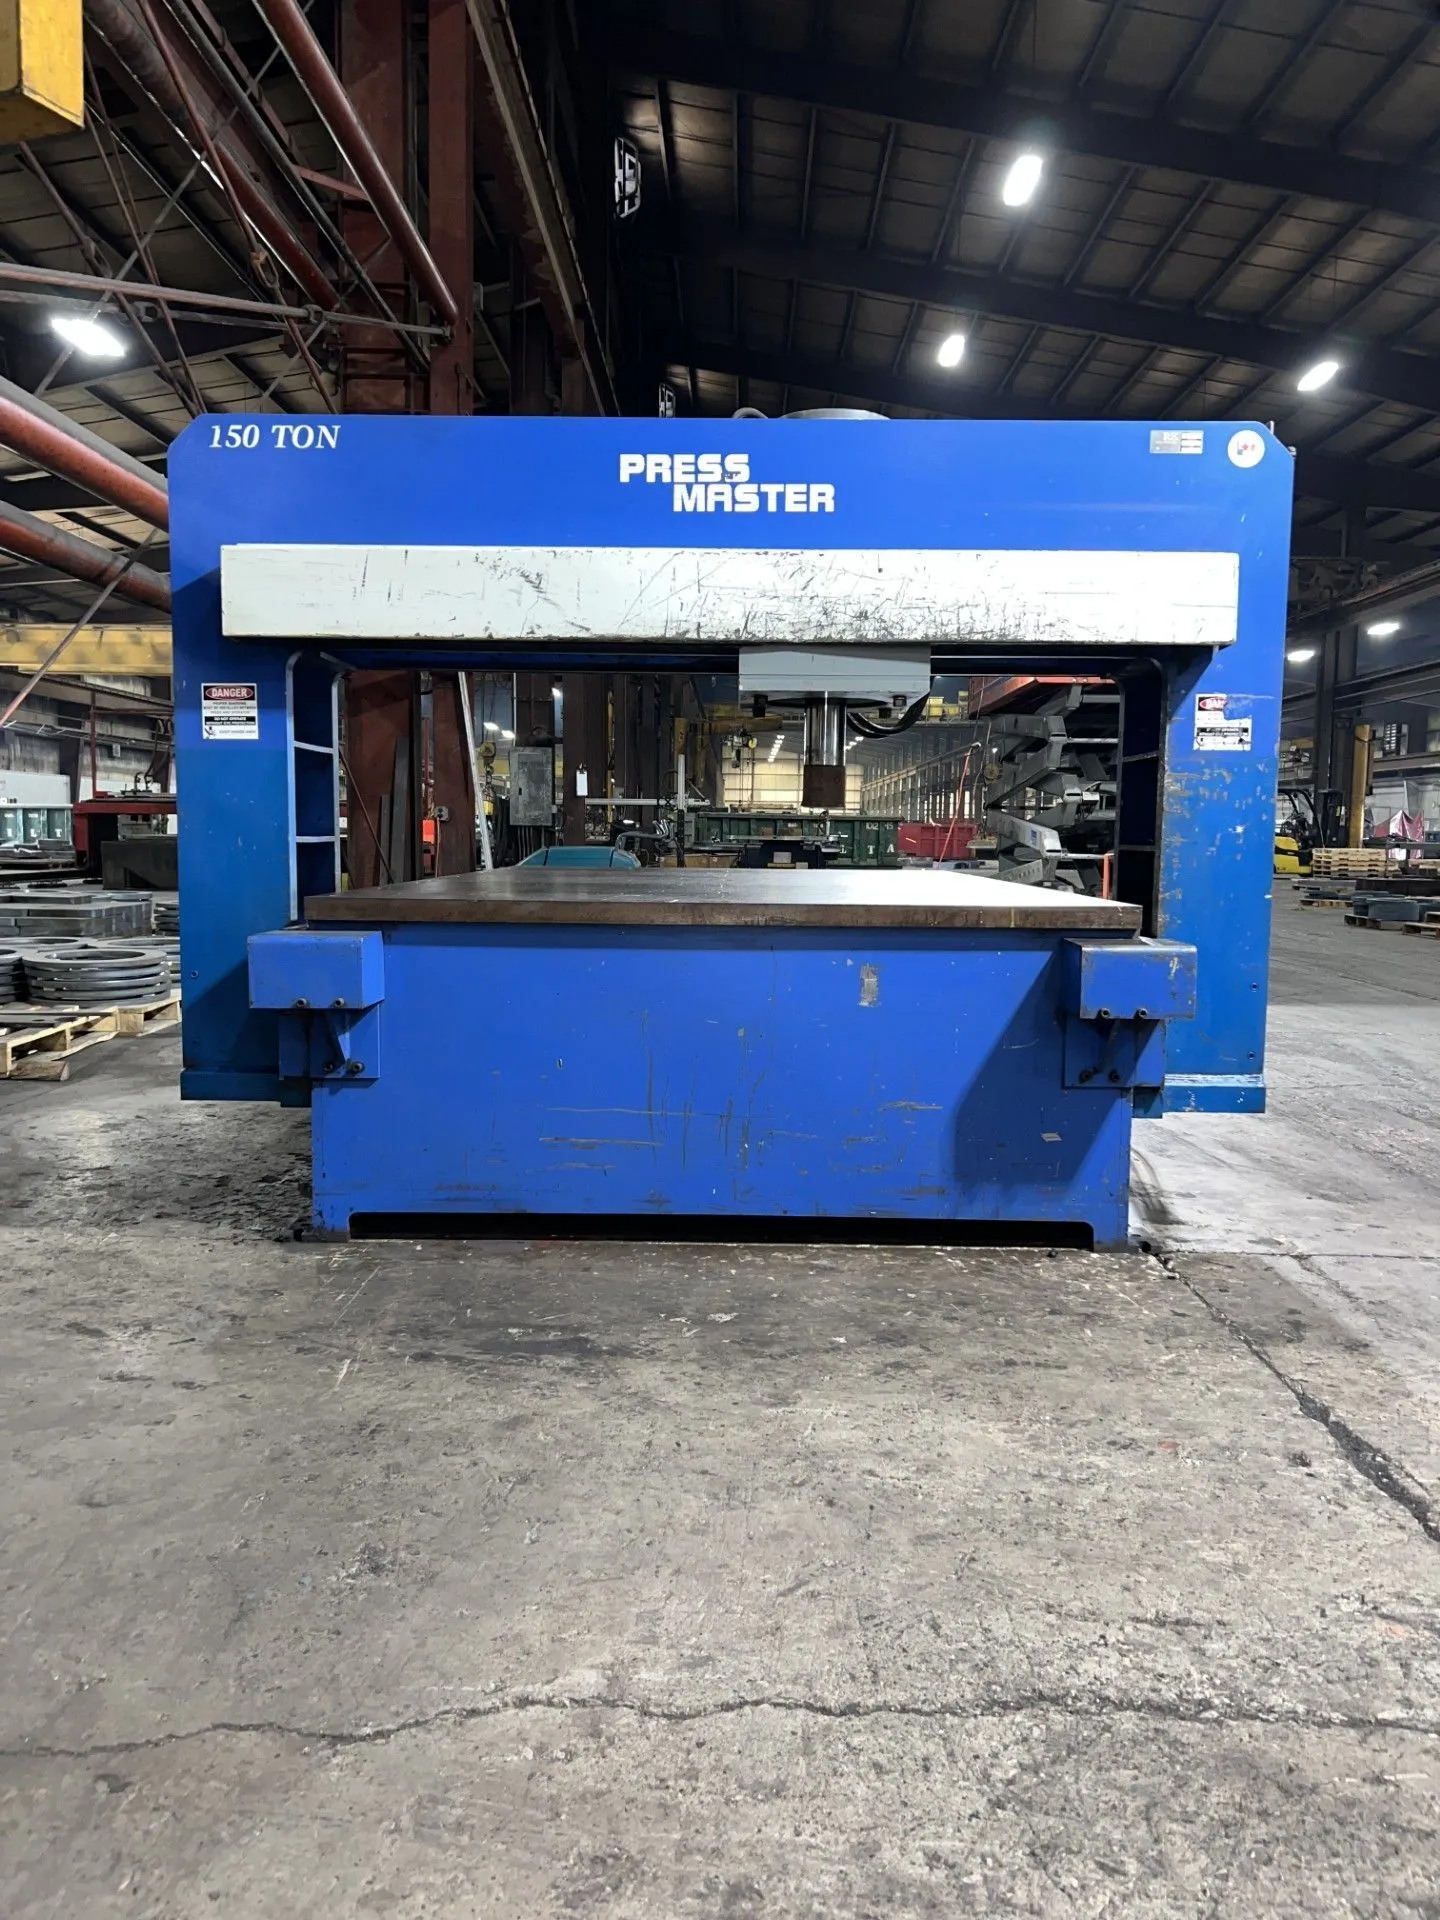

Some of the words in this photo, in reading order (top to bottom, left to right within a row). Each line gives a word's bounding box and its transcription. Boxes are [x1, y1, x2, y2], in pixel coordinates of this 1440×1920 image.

[209, 424, 260, 449] 150
[271, 424, 341, 449] TON
[619, 453, 750, 483] PRESS
[673, 483, 835, 512] MASTER
[211, 688, 247, 698] DANGER
